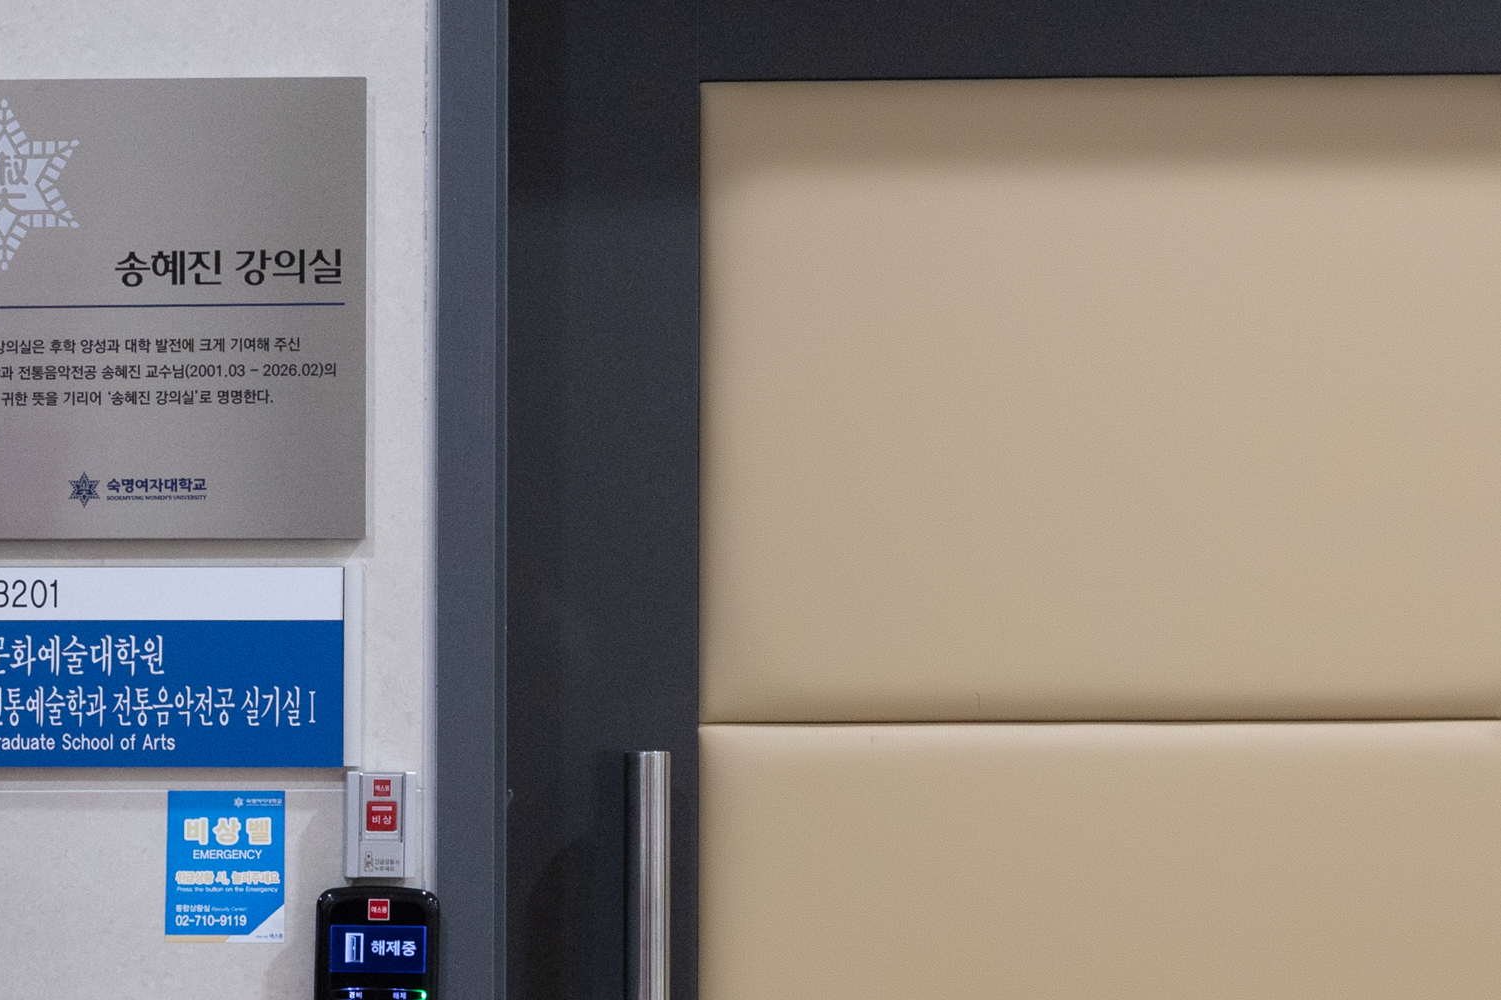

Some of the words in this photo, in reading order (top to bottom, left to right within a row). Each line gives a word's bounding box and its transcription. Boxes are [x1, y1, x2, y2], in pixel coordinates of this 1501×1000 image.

[115, 250, 222, 288] 송혜진
[235, 248, 342, 286] 강의실
[50, 339, 76, 354] 후학
[80, 339, 121, 354] 양성과
[125, 338, 151, 353] 대학
[156, 338, 195, 353] 발전에
[199, 338, 225, 352] 크게
[230, 337, 270, 352] 기여해
[274, 337, 301, 352] 주신
[18, 365, 97, 380] 전통음악전공
[101, 365, 141, 380] 송혜진
[145, 363, 246, 380] 교수님(2001.03
[263, 362, 337, 378] 2026.02)의
[1, 391, 28, 406] 귀한
[31, 391, 58, 406] 뜻을
[63, 390, 102, 406] 기리어
[217, 389, 274, 405] 명명한다.
[107, 478, 207, 493] 숙명여자대학교
[111, 685, 236, 728] 전통음악전공
[240, 685, 301, 728] 실기실
[62, 733, 114, 751] School
[120, 733, 136, 751] of
[142, 733, 176, 751] Arts
[371, 815, 393, 825] 비상
[193, 849, 262, 860] EMERGENCY
[175, 870, 215, 885] 위급상황
[231, 870, 281, 885] 눌러주세요
[245, 886, 278, 894] Emergency
[175, 914, 247, 927] 02-710-9119
[370, 939, 417, 957] 해제중
